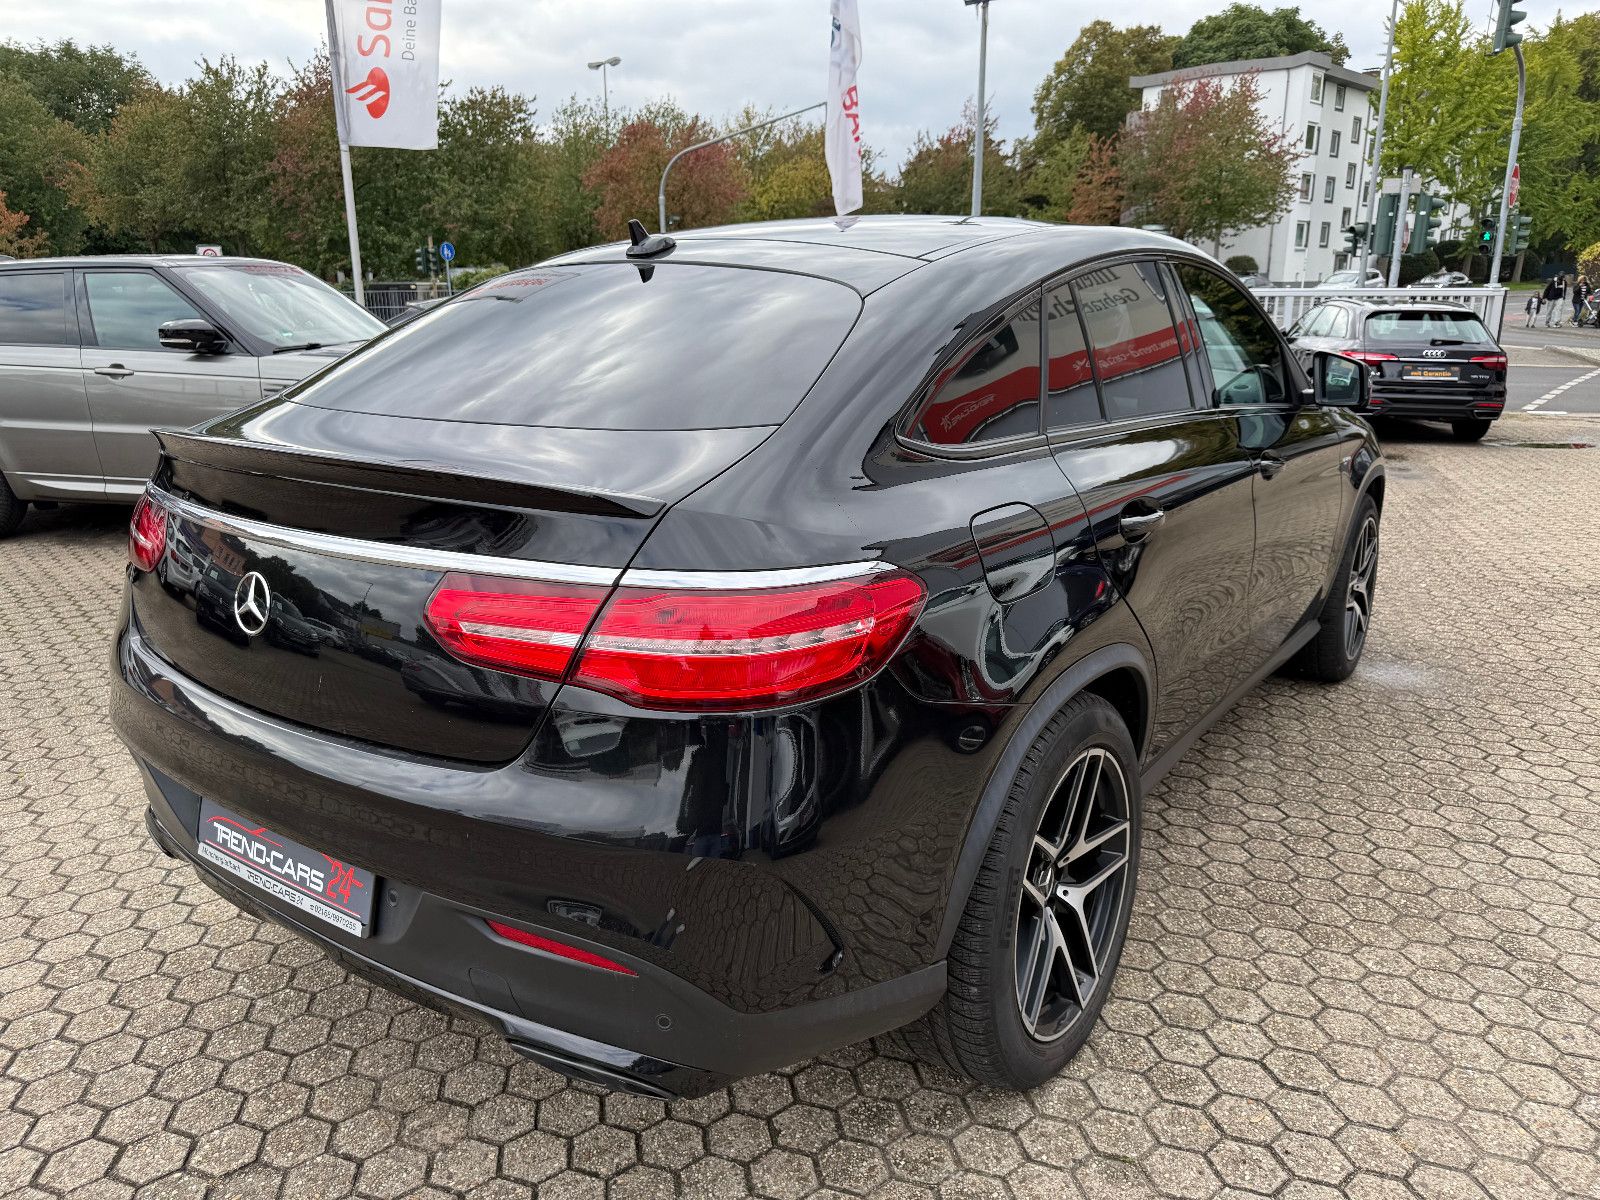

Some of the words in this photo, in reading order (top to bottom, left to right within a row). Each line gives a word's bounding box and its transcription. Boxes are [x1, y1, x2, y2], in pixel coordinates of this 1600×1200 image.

[357, 0, 393, 58] Sa
[401, 19, 417, 61] Deine
[213, 821, 325, 893] TREND-CARS
[326, 859, 364, 904] 24
